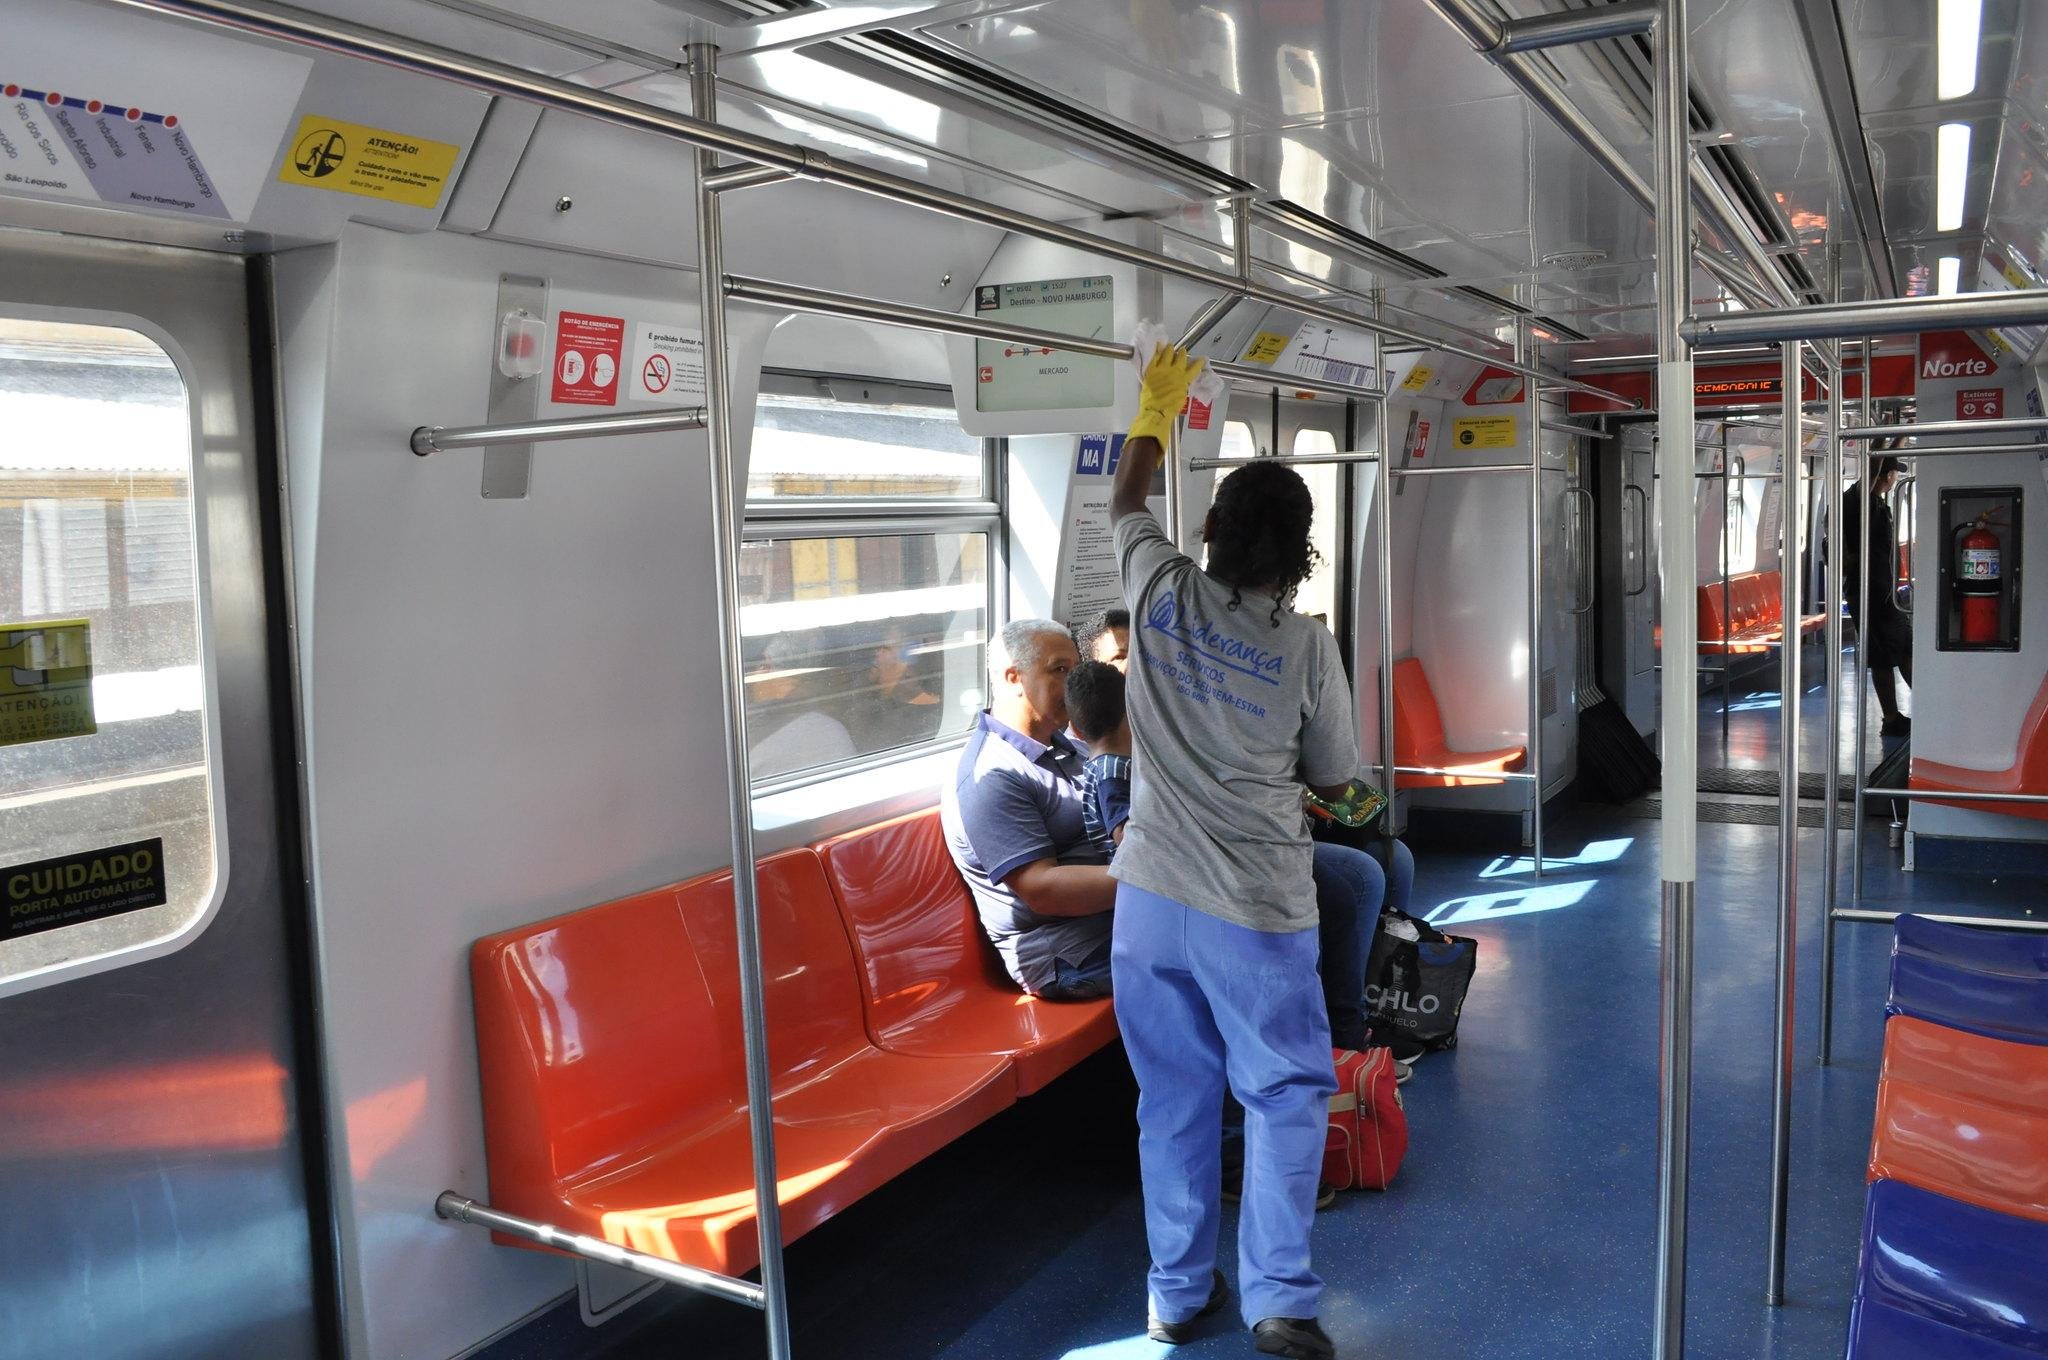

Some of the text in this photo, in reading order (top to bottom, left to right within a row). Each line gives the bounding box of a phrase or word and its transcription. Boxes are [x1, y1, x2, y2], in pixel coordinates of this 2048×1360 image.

[14, 102, 59, 166] Rio dos Sinos
[56, 110, 97, 169] Santo Afonso
[96, 118, 127, 159] Industrial
[135, 125, 155, 154] Fenac
[367, 137, 419, 155] ATENÇÃO!
[172, 131, 213, 199] Novo Hamburgo
[358, 160, 386, 171] Cuidado
[4, 173, 67, 189] São Leopoldo
[130, 192, 196, 209] Novo Hamburgo
[1010, 297, 1036, 306] Destino
[1042, 295, 1063, 304] NOVO
[1065, 291, 1107, 302] HAMBURGO
[654, 334, 678, 343] proibido
[679, 337, 697, 346] fumar
[1039, 366, 1069, 375] MERCADO
[1922, 357, 1987, 378] Norte
[1081, 448, 1100, 469] MA
[1171, 605, 1285, 675] Liderança
[1176, 651, 1226, 684] SERVIÇOS
[1176, 682, 1191, 696] ISO
[1178, 668, 1193, 684] DO
[1194, 679, 1211, 695] SEU
[8, 849, 154, 900] CUIDADO
[10, 877, 155, 917] PORTA AUTOMÁTICA
[1365, 983, 1440, 1014] CHLO
